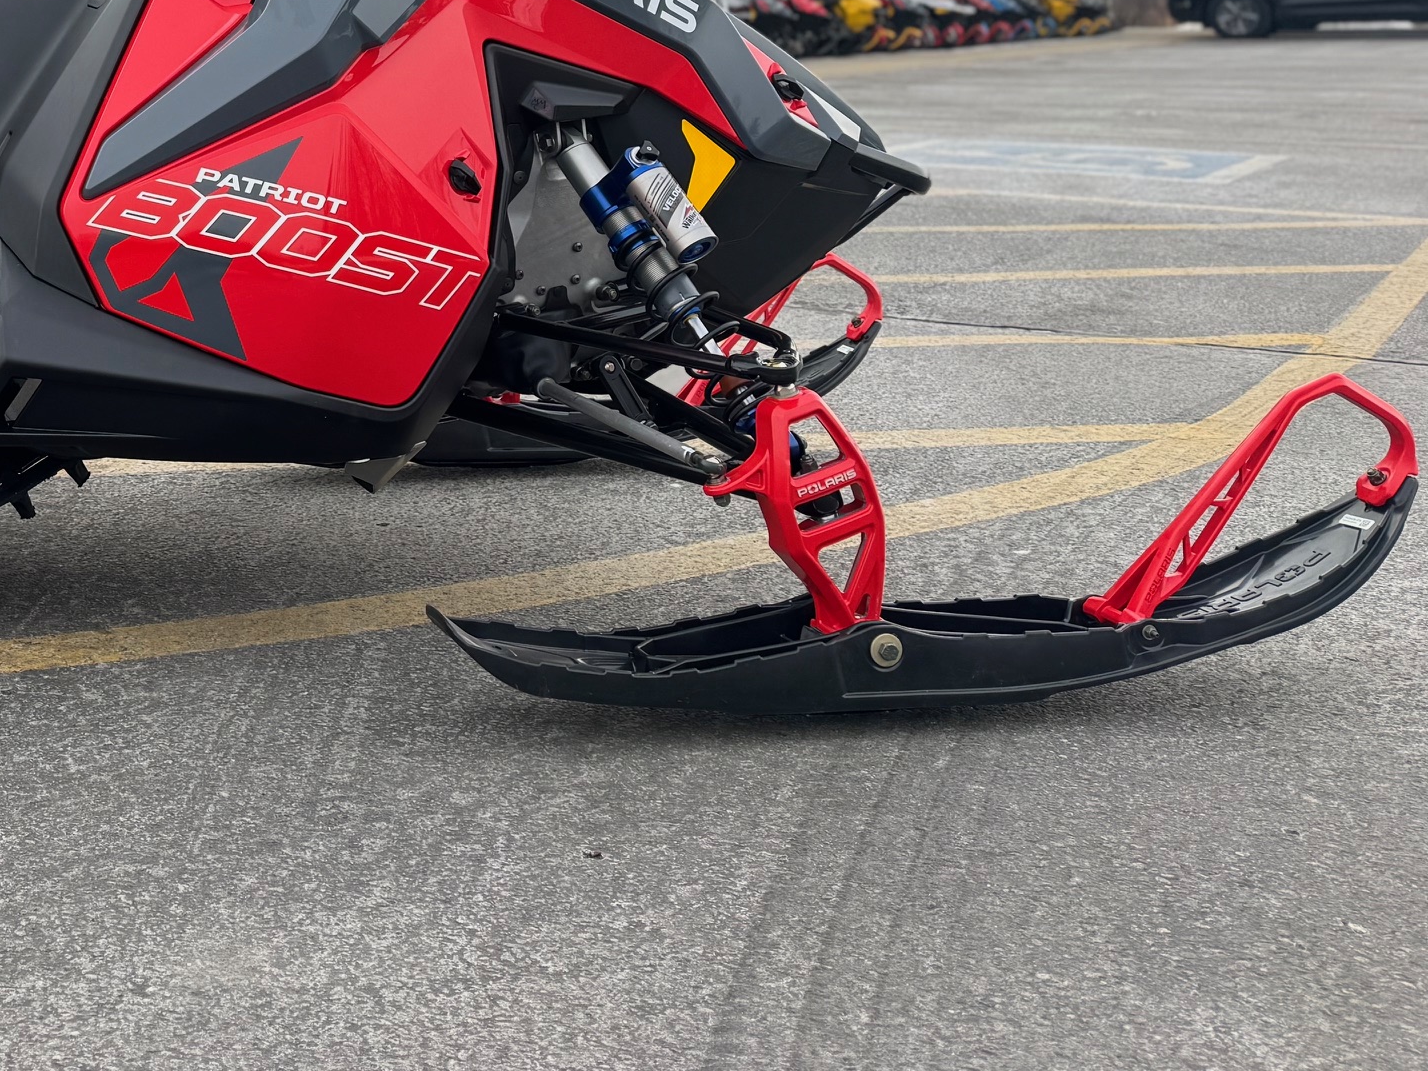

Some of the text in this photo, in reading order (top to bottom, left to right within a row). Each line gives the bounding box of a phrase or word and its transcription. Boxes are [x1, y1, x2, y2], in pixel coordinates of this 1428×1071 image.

[195, 167, 349, 215] PATRIOT
[86, 178, 481, 310] BOOST
[796, 468, 858, 499] POLARIS
[1145, 547, 1176, 603] POLARIS
[1177, 549, 1332, 620] POLARIS
